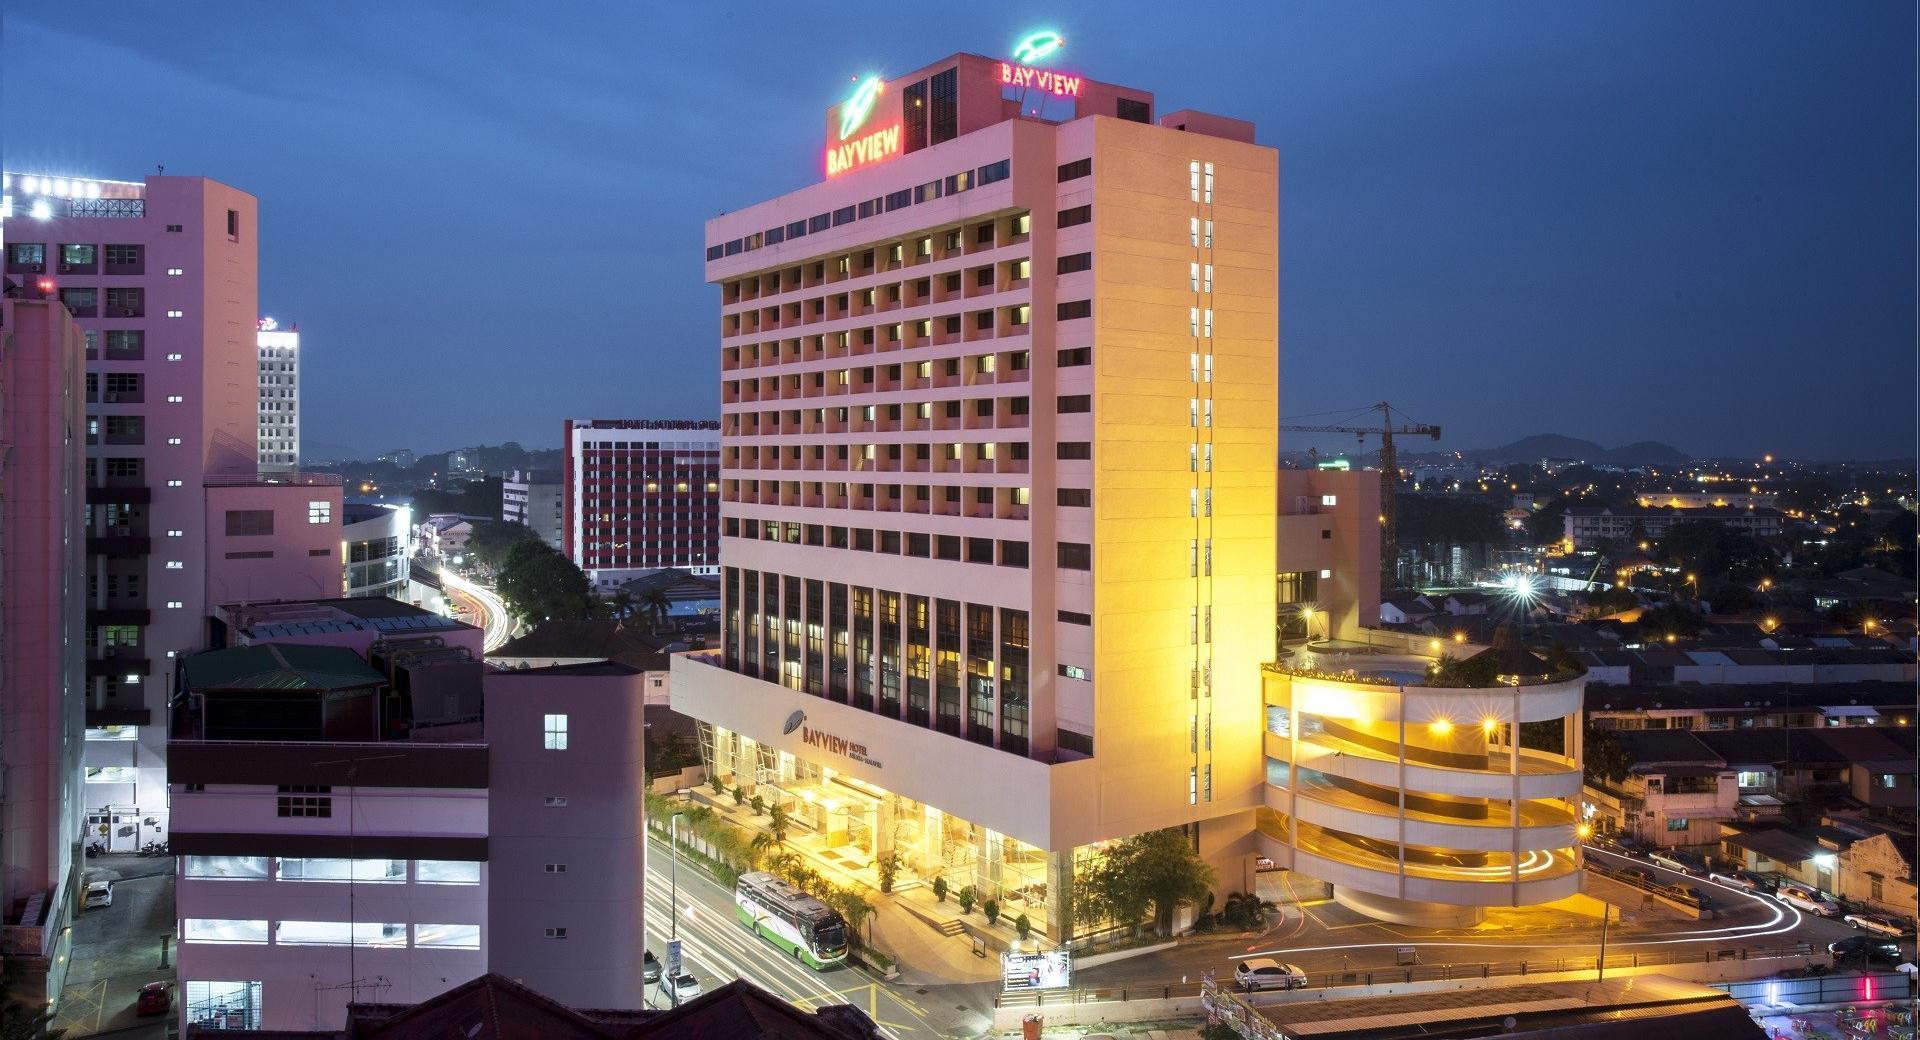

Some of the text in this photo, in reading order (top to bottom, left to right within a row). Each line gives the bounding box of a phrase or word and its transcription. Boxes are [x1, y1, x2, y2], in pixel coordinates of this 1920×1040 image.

[1002, 63, 1080, 96] BAYVIEW
[828, 125, 899, 175] BAYVIEW
[803, 726, 868, 756] BAYVIEW HOTEL
